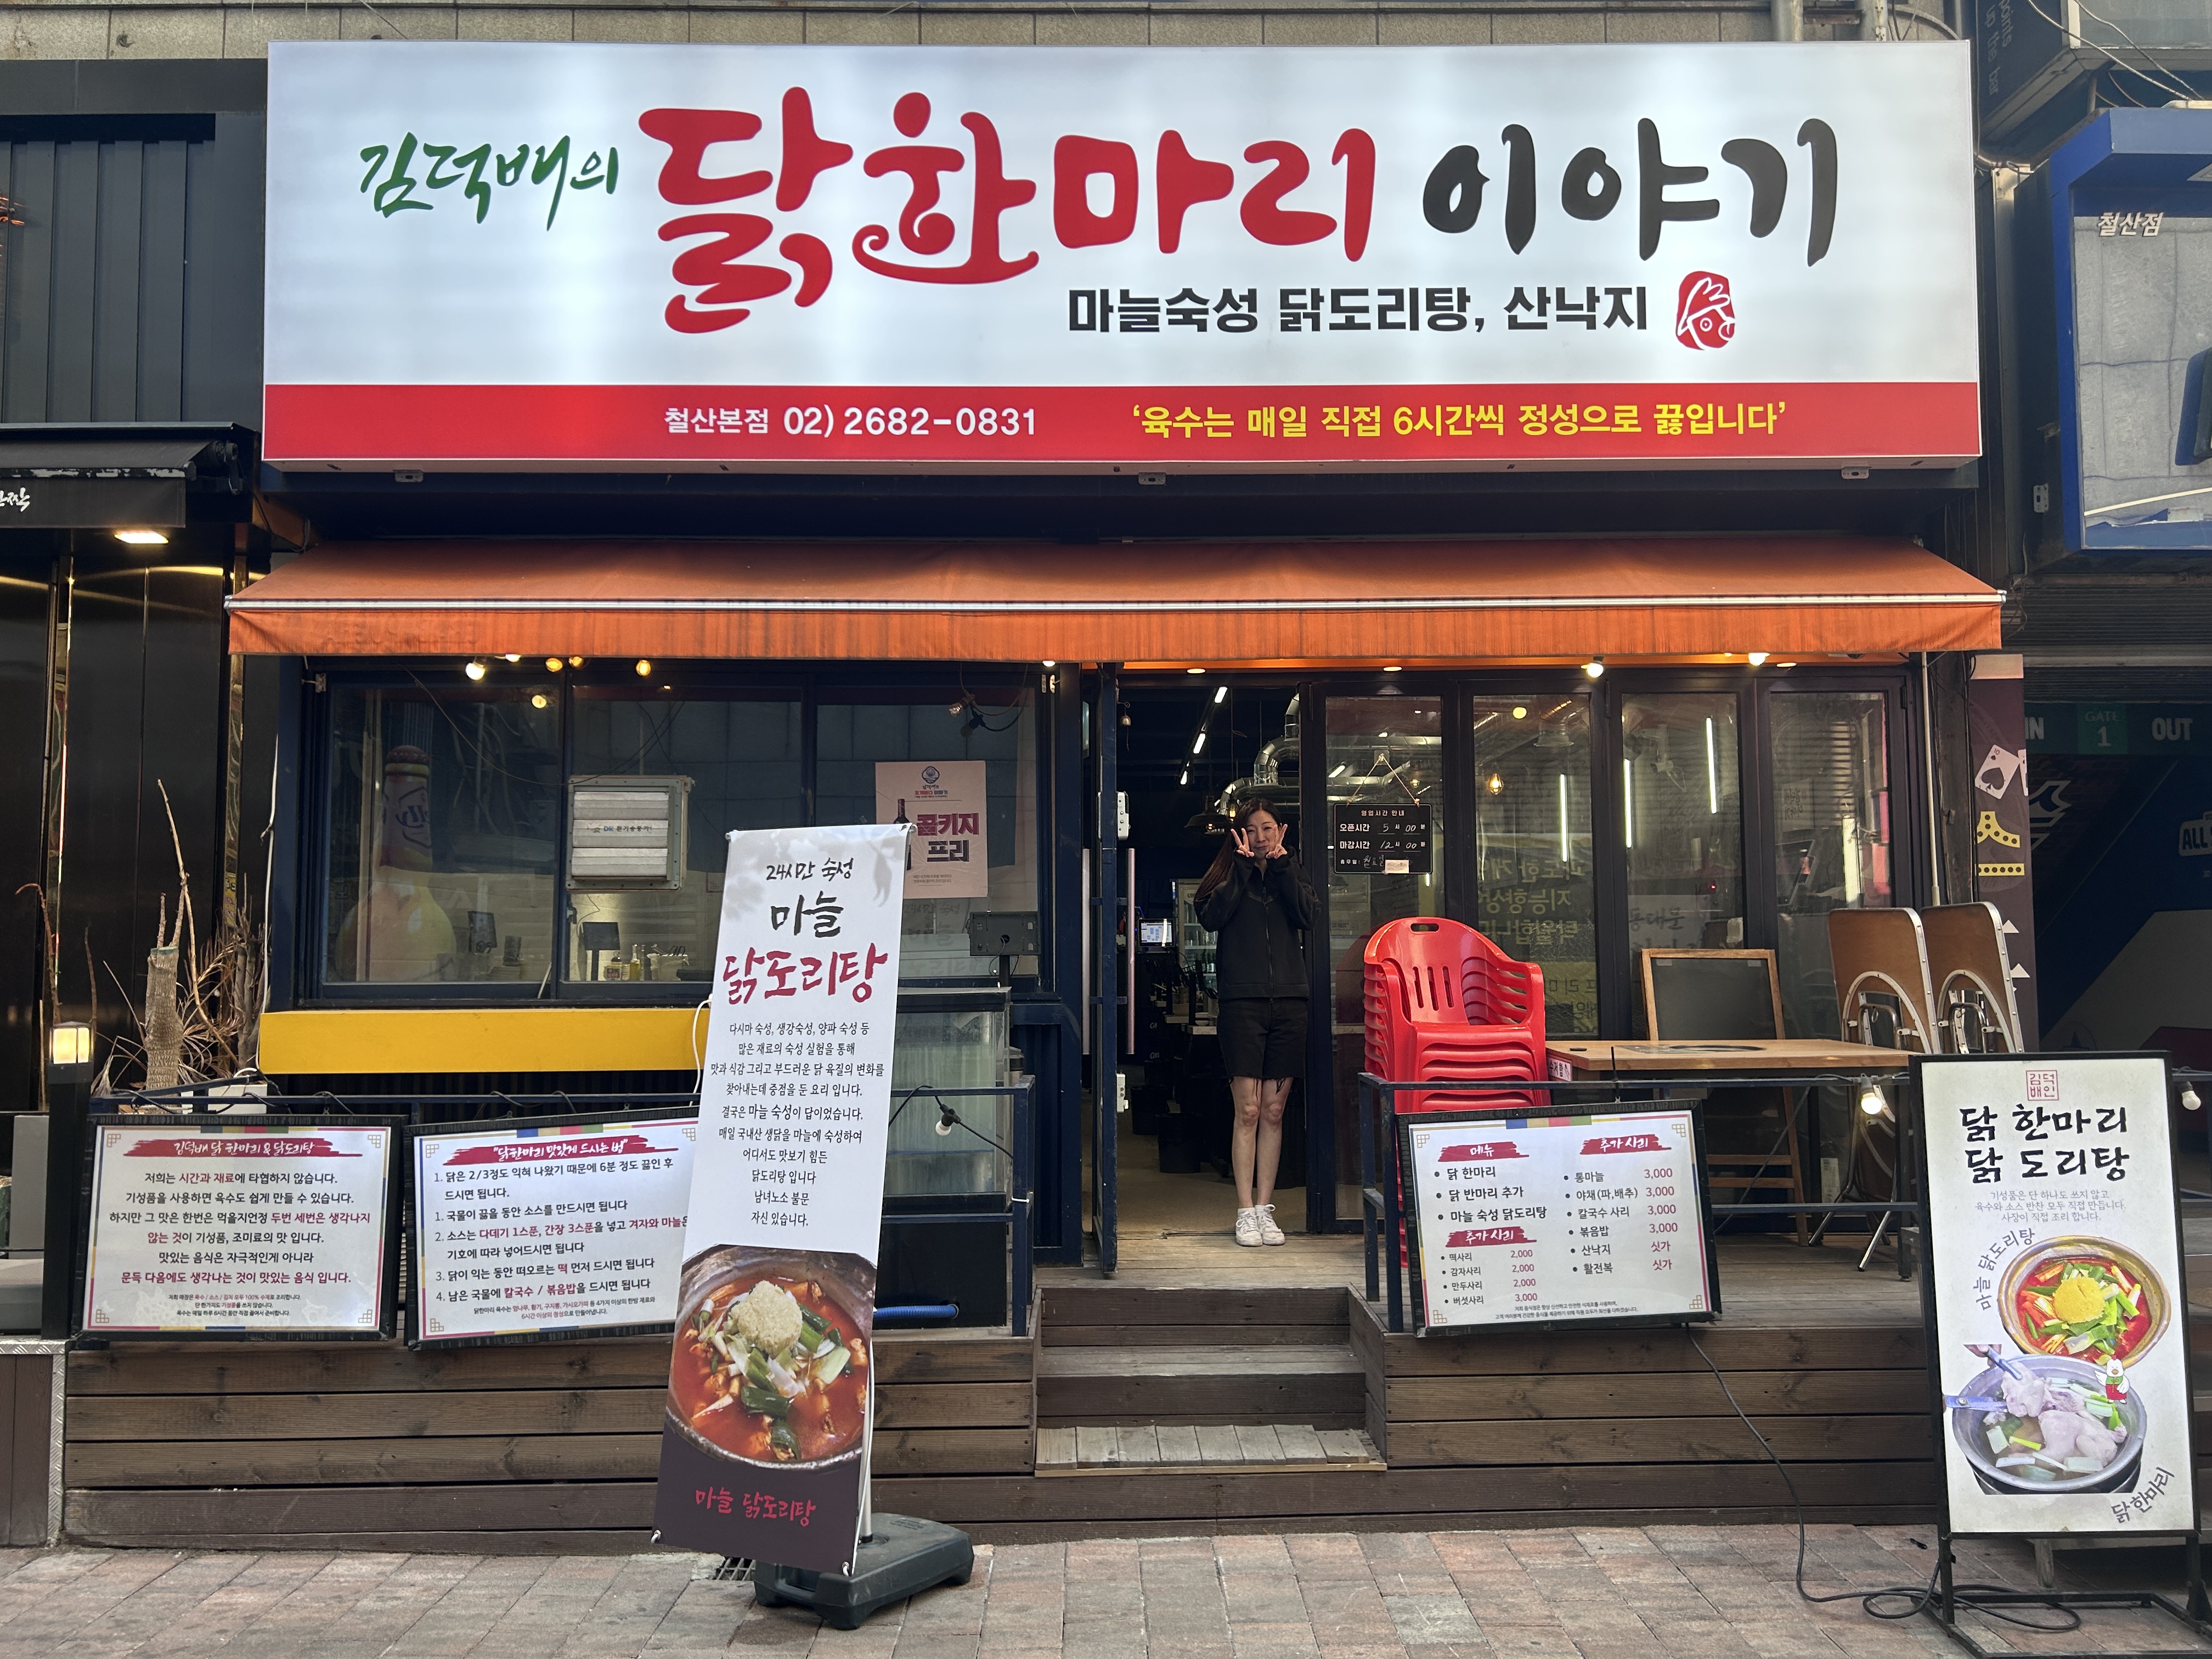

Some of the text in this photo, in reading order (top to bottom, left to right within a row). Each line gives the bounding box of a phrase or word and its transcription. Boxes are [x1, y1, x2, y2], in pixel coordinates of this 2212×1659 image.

[360, 88, 1837, 333] 김덕배의 닭한마리 이야기
[2098, 212, 2164, 237] 철산점
[1070, 287, 1646, 332] 마늘숙성 닭도리탕, 산낙지
[665, 405, 1034, 437] 철산본점 02) 2682-0831
[1249, 407, 1306, 437] 매일
[1322, 407, 1380, 436] 직접
[1394, 405, 1503, 436] 6시간씩
[1520, 405, 1641, 435] 정성으로
[2085, 711, 2119, 722] GATE
[2097, 726, 2112, 747] 1
[2152, 718, 2193, 741] OUT
[917, 813, 979, 836] 콜키지
[1339, 823, 1370, 832] 오픈시간
[1383, 823, 1389, 832] 5
[1339, 841, 1370, 849] 마감시간
[1380, 840, 1394, 849] 12
[2182, 828, 2208, 850] ALL
[927, 840, 969, 862] 프리
[822, 857, 854, 882] 숙성
[771, 891, 844, 938] 마늘
[723, 943, 888, 1004] 닭도리탕
[730, 1022, 870, 1036] 다시마 숙성, 생강숙성, 양파 숙성 등
[739, 1042, 855, 1056] 많은 재료의 숙성 실험을 통해
[1959, 1103, 2128, 1142] 닭 한마리
[174, 1141, 315, 1155] 김덕배 닭 한마리 & 닭도리탕
[546, 1144, 578, 1159] 맛있게
[579, 1141, 609, 1155] 드시는
[1470, 1145, 1495, 1157] 메뉴
[1599, 1136, 1649, 1151] 추가 사리
[1965, 1147, 2130, 1183] 닭 도리탕
[145, 1172, 337, 1184] 저희는 시간과 재료에 타협하지 않습니다.
[753, 1169, 816, 1185] 닭도리탕 입니다
[1447, 1166, 1496, 1180] 닭 한마리
[1575, 1168, 1672, 1183] 통마늘 3,000
[445, 1188, 509, 1200] 드시면 됩니다.
[1449, 1187, 1523, 1201] 닭 반마리 추가
[1577, 1187, 1674, 1201] 야채(파,배추) 3,000
[1991, 1190, 2109, 1200] 기성품은 단 하나도 쓰지 않고
[1578, 1205, 1676, 1219] 칼국수 사리 3,000
[1976, 1202, 2002, 1211] 육수와
[2027, 1201, 2044, 1211] 반찬
[2069, 1201, 2084, 1210] 직접
[751, 1211, 808, 1227] 자신 있습니다.
[1451, 1206, 1547, 1222] 마늘 숙성 닭도리탕
[1465, 1229, 1514, 1244] 추가 사리
[1579, 1223, 1678, 1237] 볶음밥 3,000
[448, 1242, 584, 1260] 기호에 따라 넣어드시면 됩니다
[1449, 1250, 1532, 1262] 떡사리 2,000
[1582, 1241, 1671, 1256] 산낙지 싯가
[1583, 1259, 1672, 1274] 활전복 싯가
[1973, 1228, 2035, 1310] 마늘 닭도리탕
[1453, 1293, 1537, 1305] 버섯사리 3,000
[695, 1487, 816, 1527] 마늘 닭도리탕
